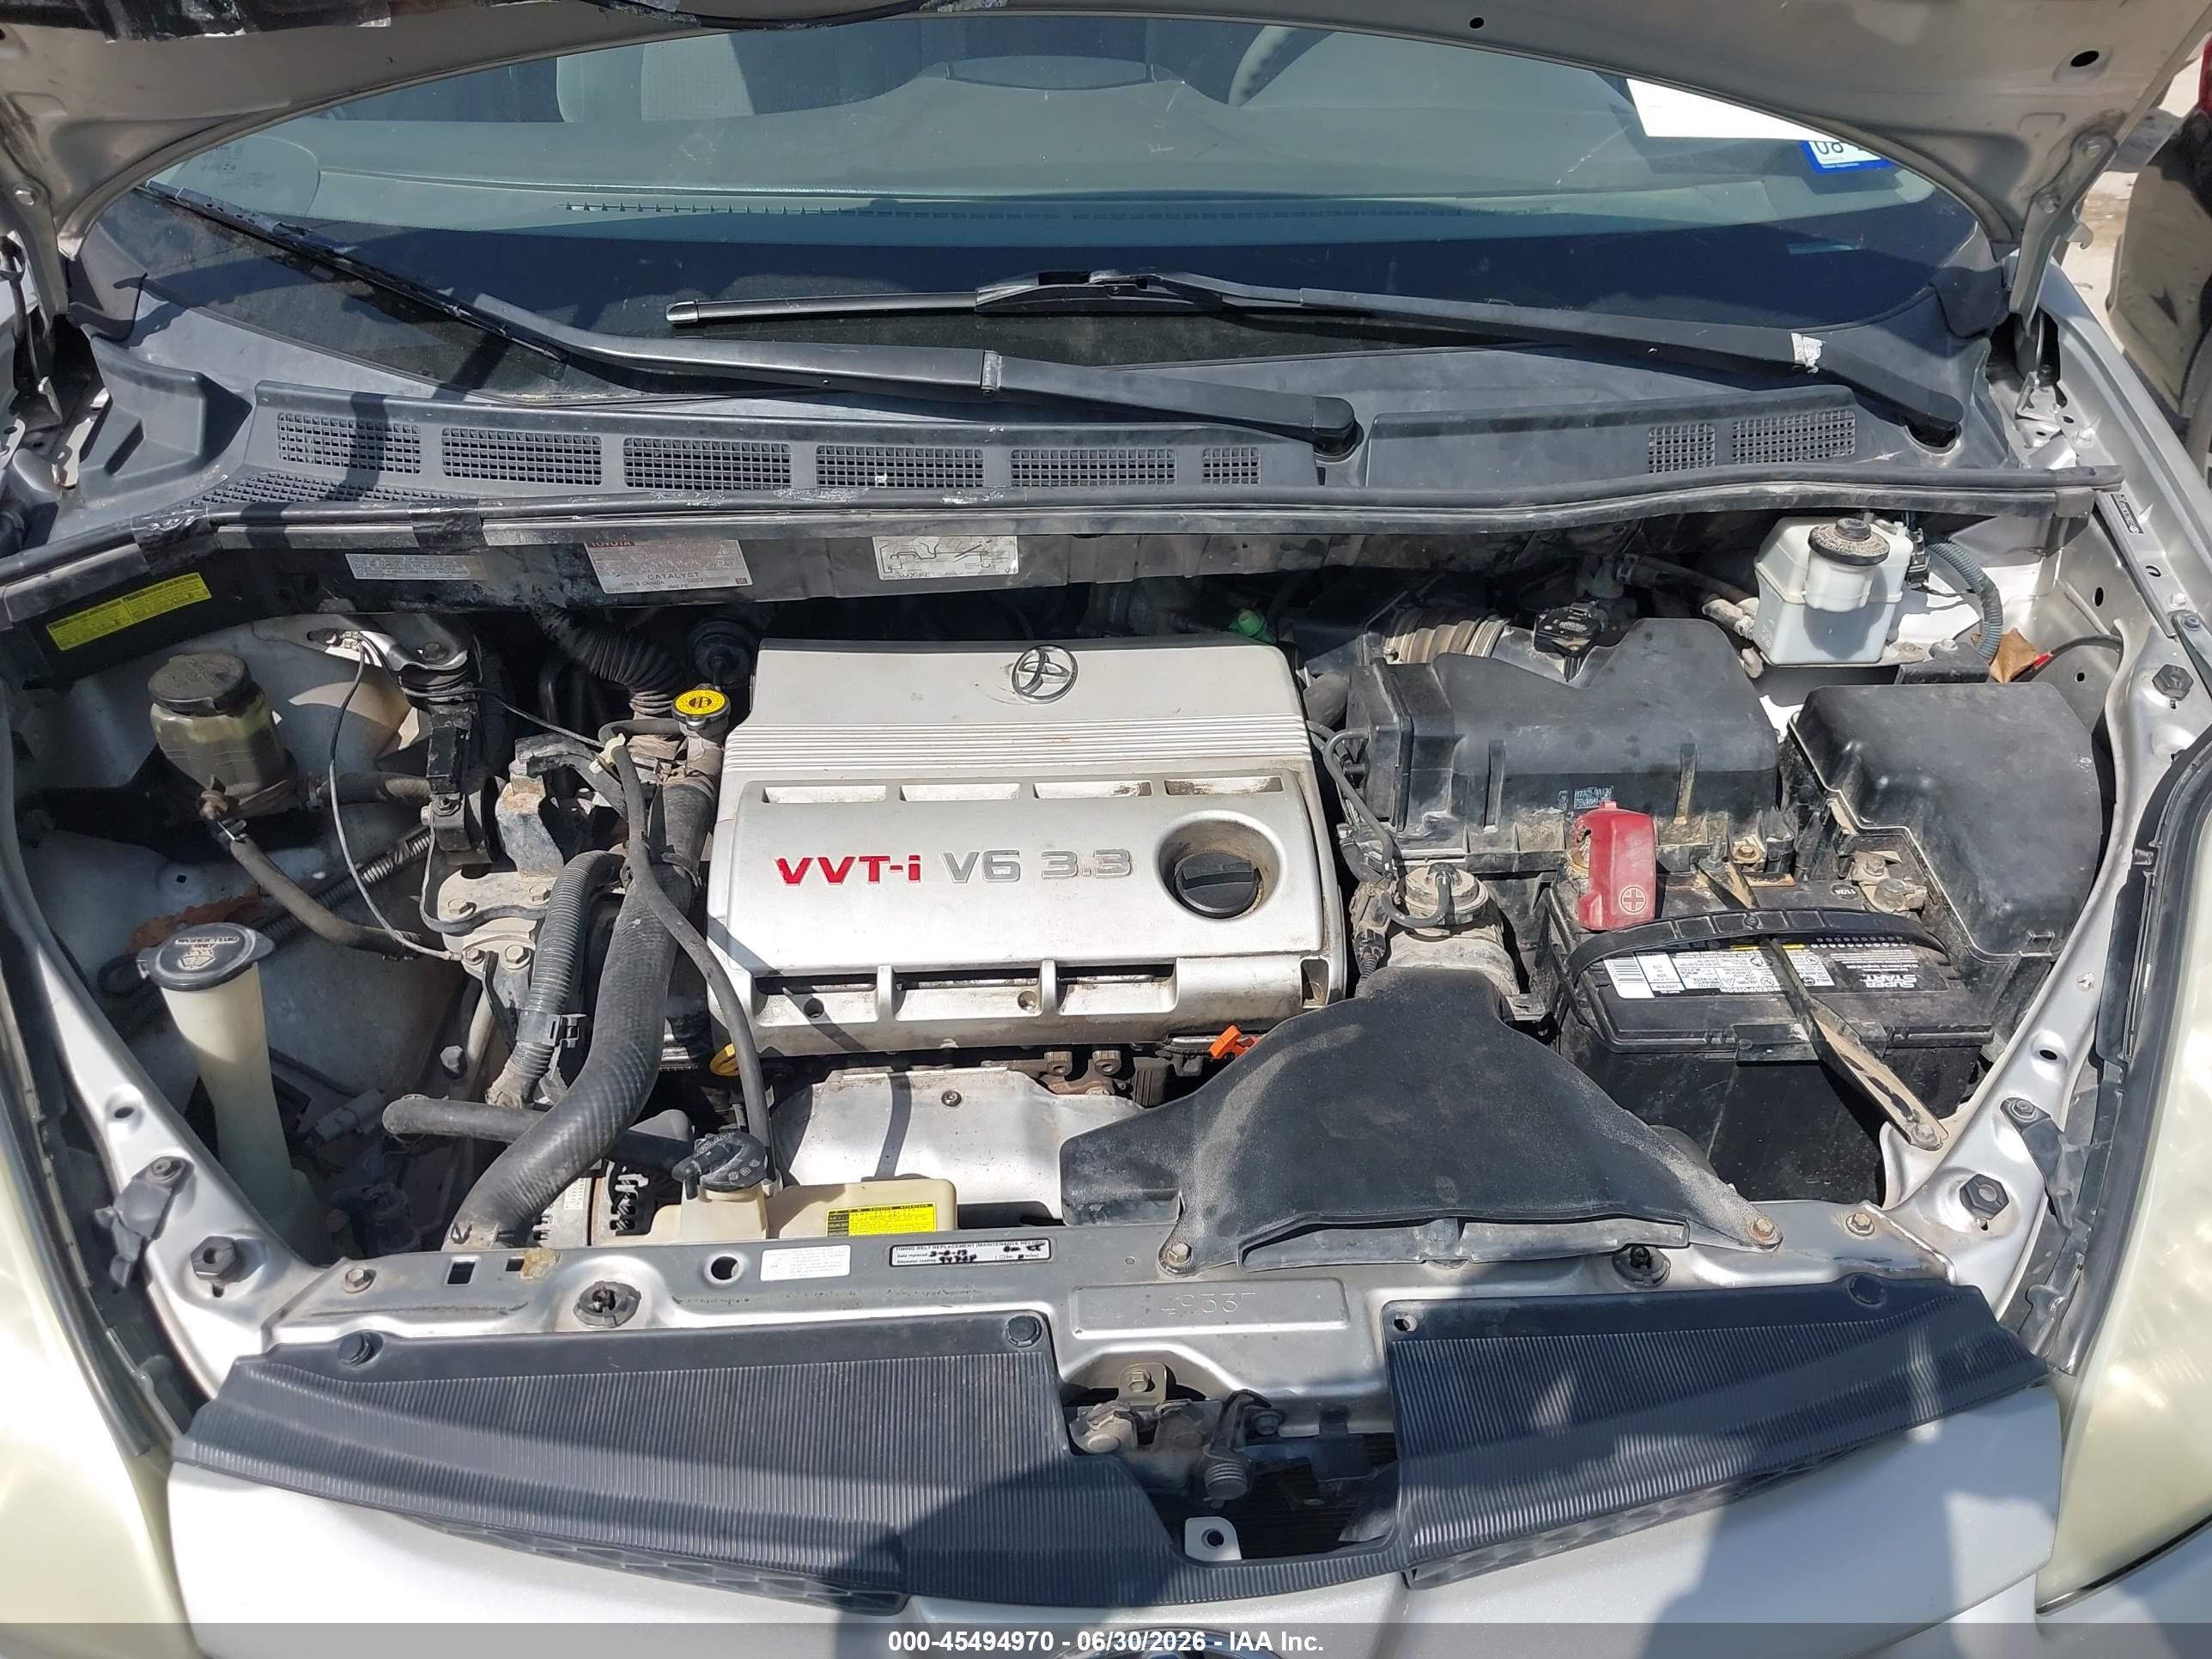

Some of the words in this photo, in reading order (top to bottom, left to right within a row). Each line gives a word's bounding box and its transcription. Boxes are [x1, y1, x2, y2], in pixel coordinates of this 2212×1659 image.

[775, 855, 922, 885] VVT-i
[941, 849, 1022, 885] V6
[1042, 848, 1132, 881] 3.3
